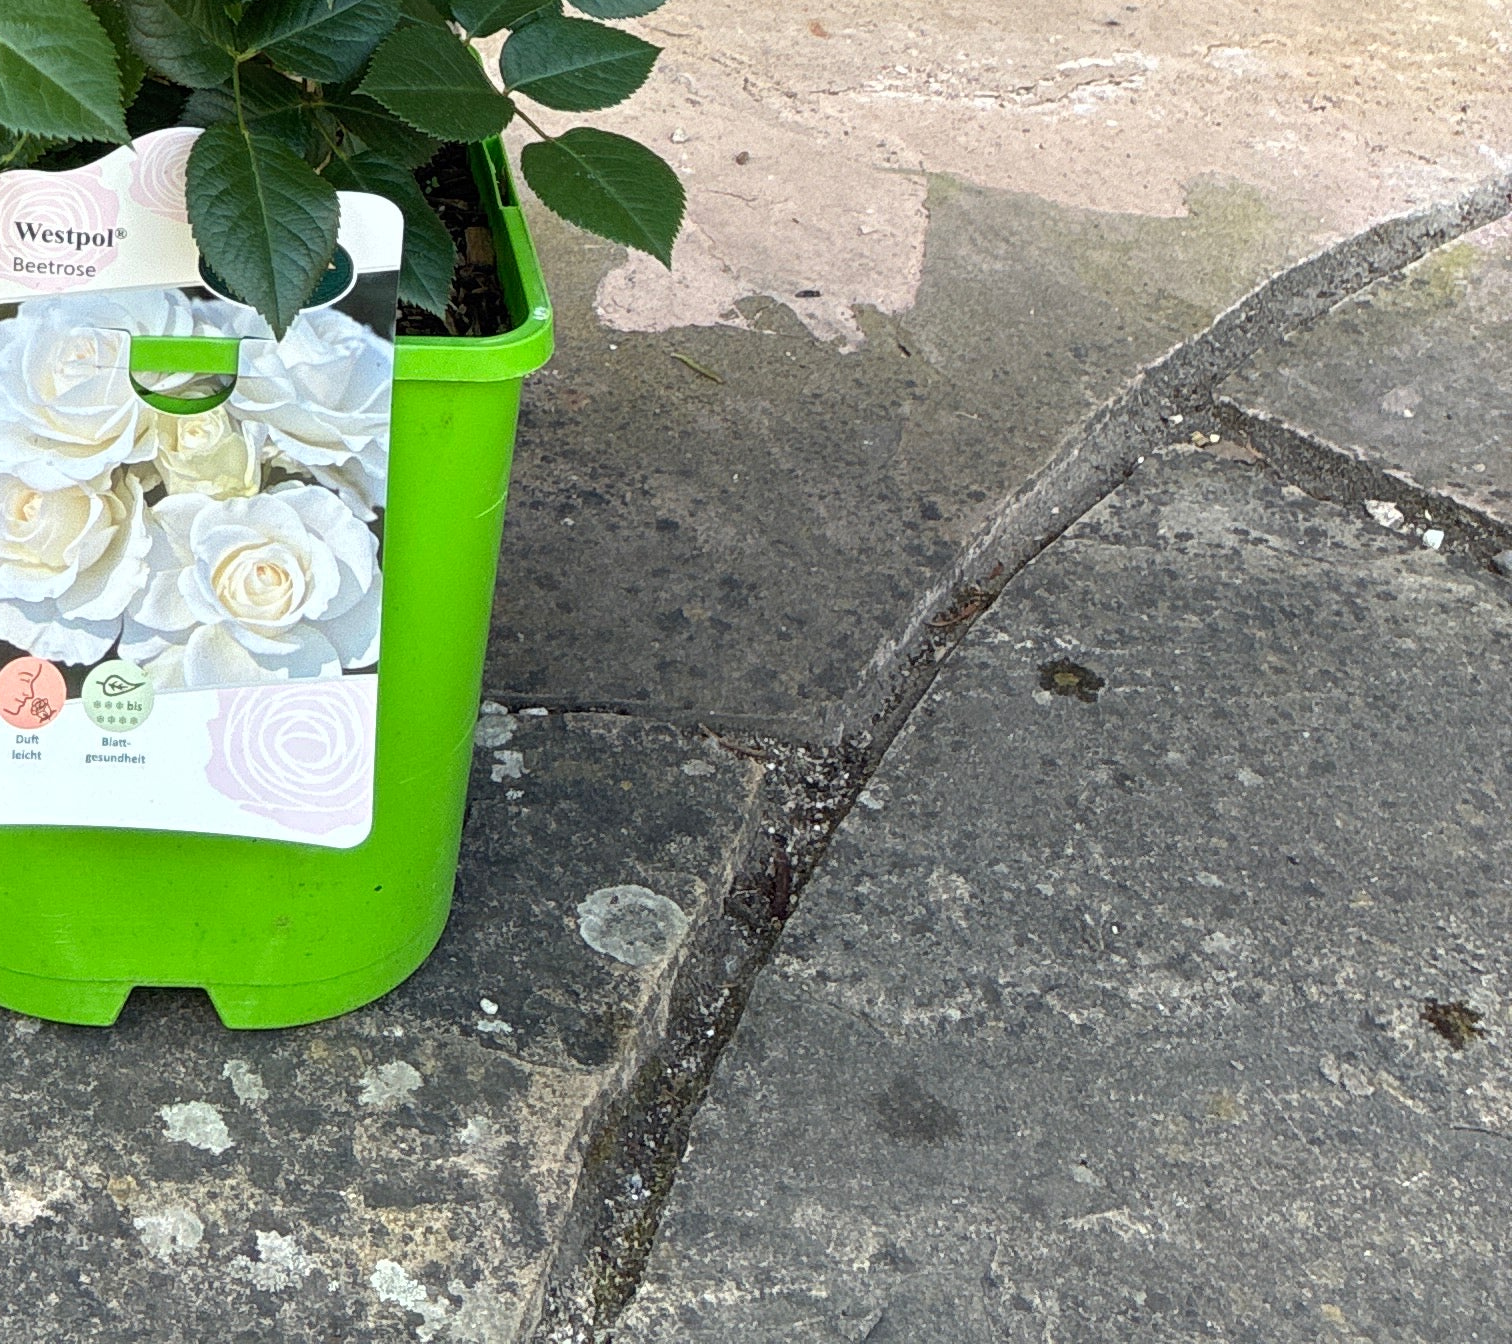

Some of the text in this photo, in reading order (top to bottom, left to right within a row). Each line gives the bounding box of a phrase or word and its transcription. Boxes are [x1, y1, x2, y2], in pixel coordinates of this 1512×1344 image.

[13, 257, 96, 277] Beetrose
[126, 700, 143, 711] bis
[15, 734, 39, 744] Duft
[102, 737, 131, 747] Blatt-
[12, 750, 42, 760] leicht
[85, 753, 146, 764] gesundheit
